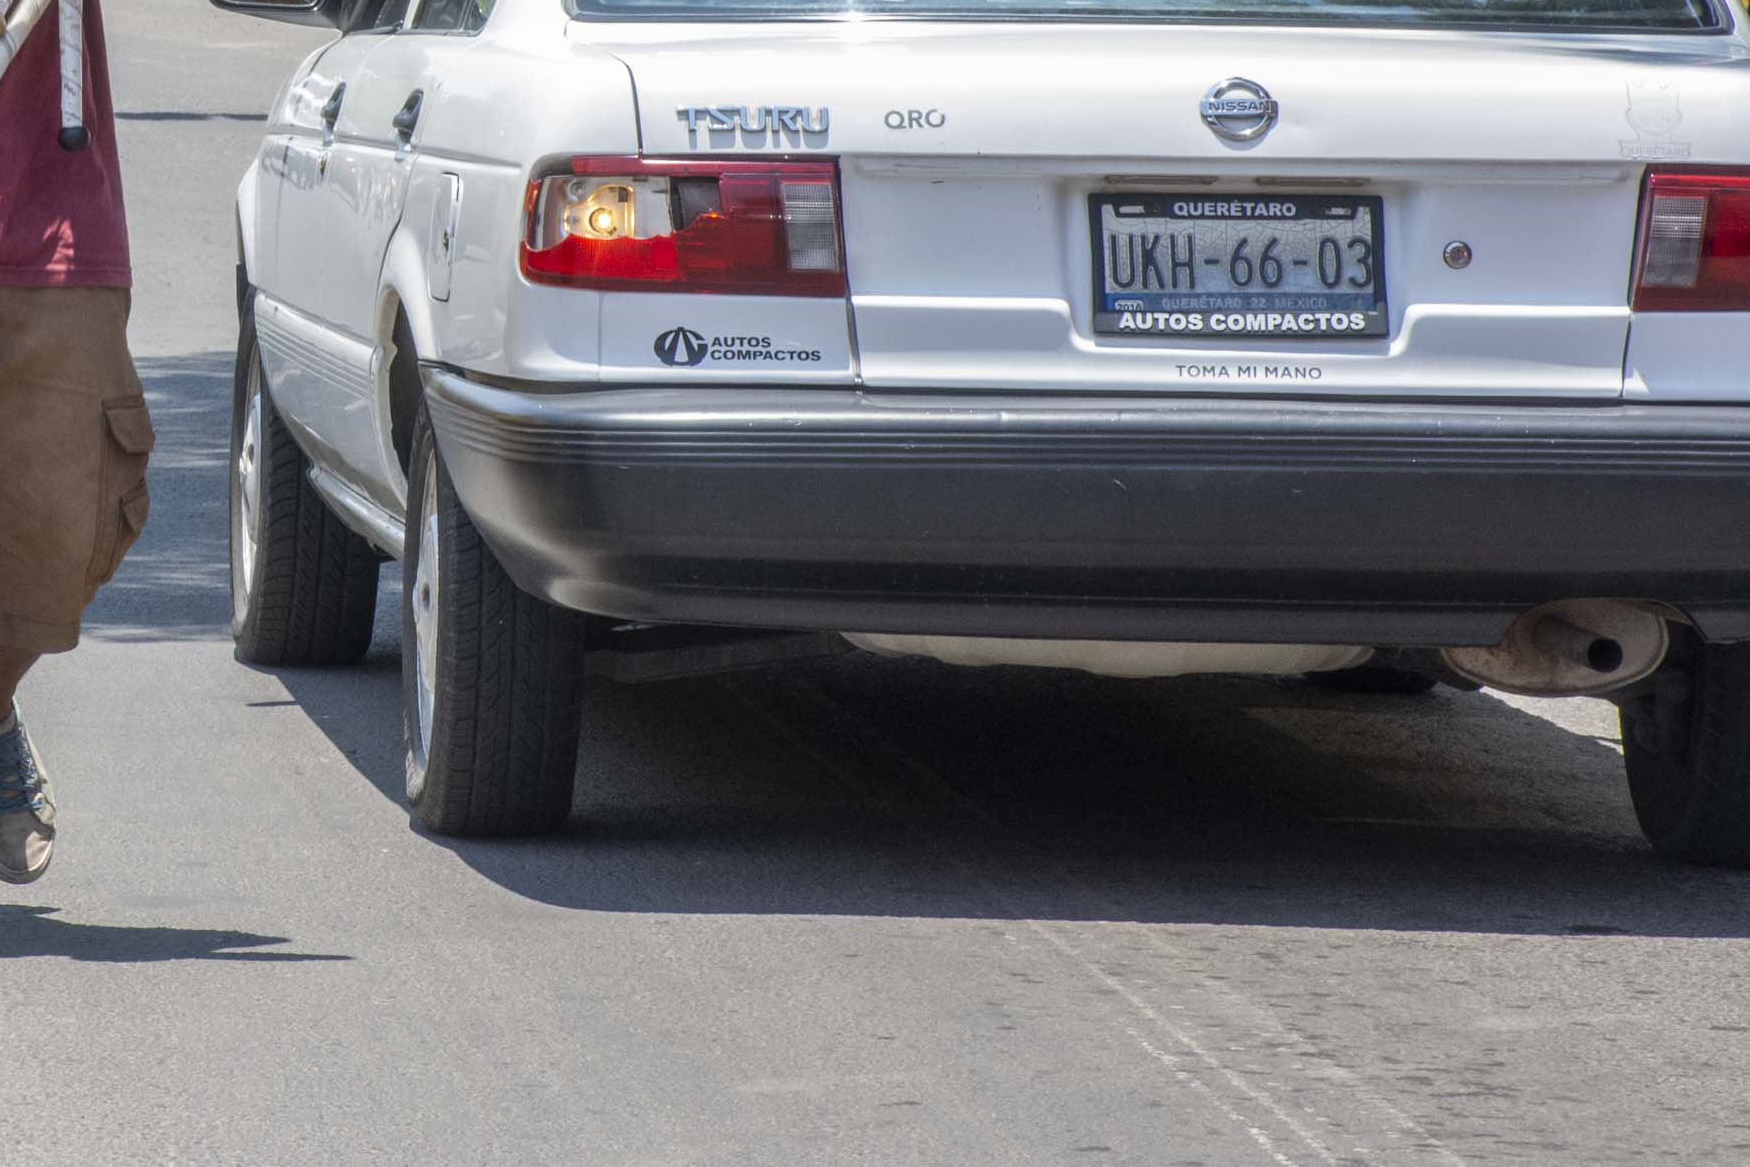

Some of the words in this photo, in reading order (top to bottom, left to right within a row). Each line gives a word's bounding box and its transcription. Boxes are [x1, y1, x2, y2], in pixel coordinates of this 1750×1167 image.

[1209, 100, 1271, 112] NISSAN
[676, 105, 830, 132] TSURU
[884, 108, 946, 130] QRO
[1109, 233, 1373, 290] UKH-66-03
[1119, 313, 1204, 332] AUTOS
[1209, 313, 1366, 332] COMPACTOS
[711, 336, 771, 349] AUTOS
[710, 349, 822, 362] COMPACTOS
[1175, 365, 1231, 379] TOMA
[1237, 365, 1258, 379] MI
[1264, 366, 1323, 380] MANO
